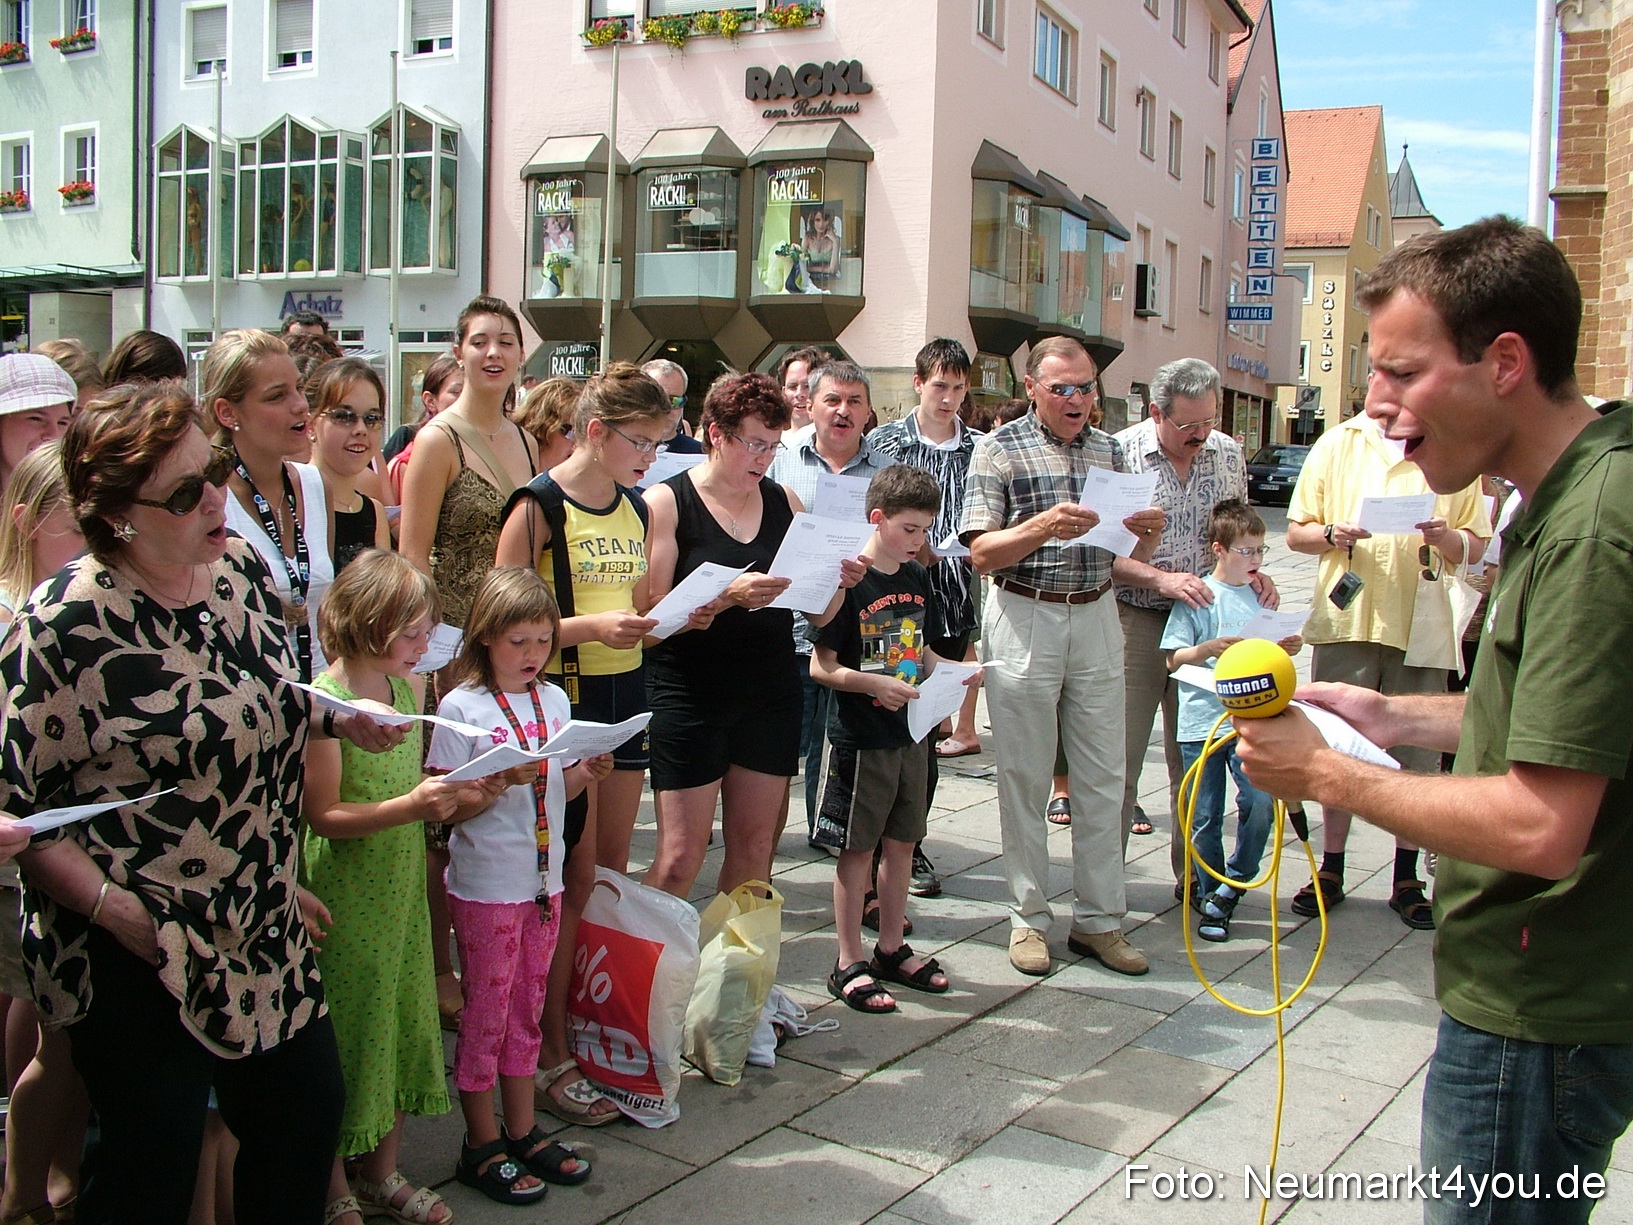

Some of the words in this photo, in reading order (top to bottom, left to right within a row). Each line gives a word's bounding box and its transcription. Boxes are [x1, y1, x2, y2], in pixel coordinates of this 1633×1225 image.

[745, 59, 873, 101] RACKL
[762, 108, 788, 118] am
[791, 99, 860, 117] Rathaus
[654, 174, 668, 185] 100
[669, 172, 693, 184] Jahre
[775, 168, 790, 179] 100
[791, 165, 816, 177] Jahre
[541, 180, 554, 191] 100
[555, 178, 577, 190] Jahre
[770, 179, 809, 201] RACKL
[538, 191, 571, 212] RACKL
[650, 185, 686, 206] RACKL
[1252, 143, 1273, 291] BETTEN
[279, 291, 343, 320] Achatz
[1230, 308, 1270, 319] WIMMER
[555, 345, 569, 355] 100
[569, 344, 591, 355] Jahre
[551, 356, 585, 375] RACKL
[579, 537, 644, 559] TEAM
[604, 562, 631, 573] 1984
[859, 609, 869, 620] I
[898, 593, 912, 603] DO
[1217, 678, 1270, 694] antenne
[1222, 692, 1273, 706] BAYERN
